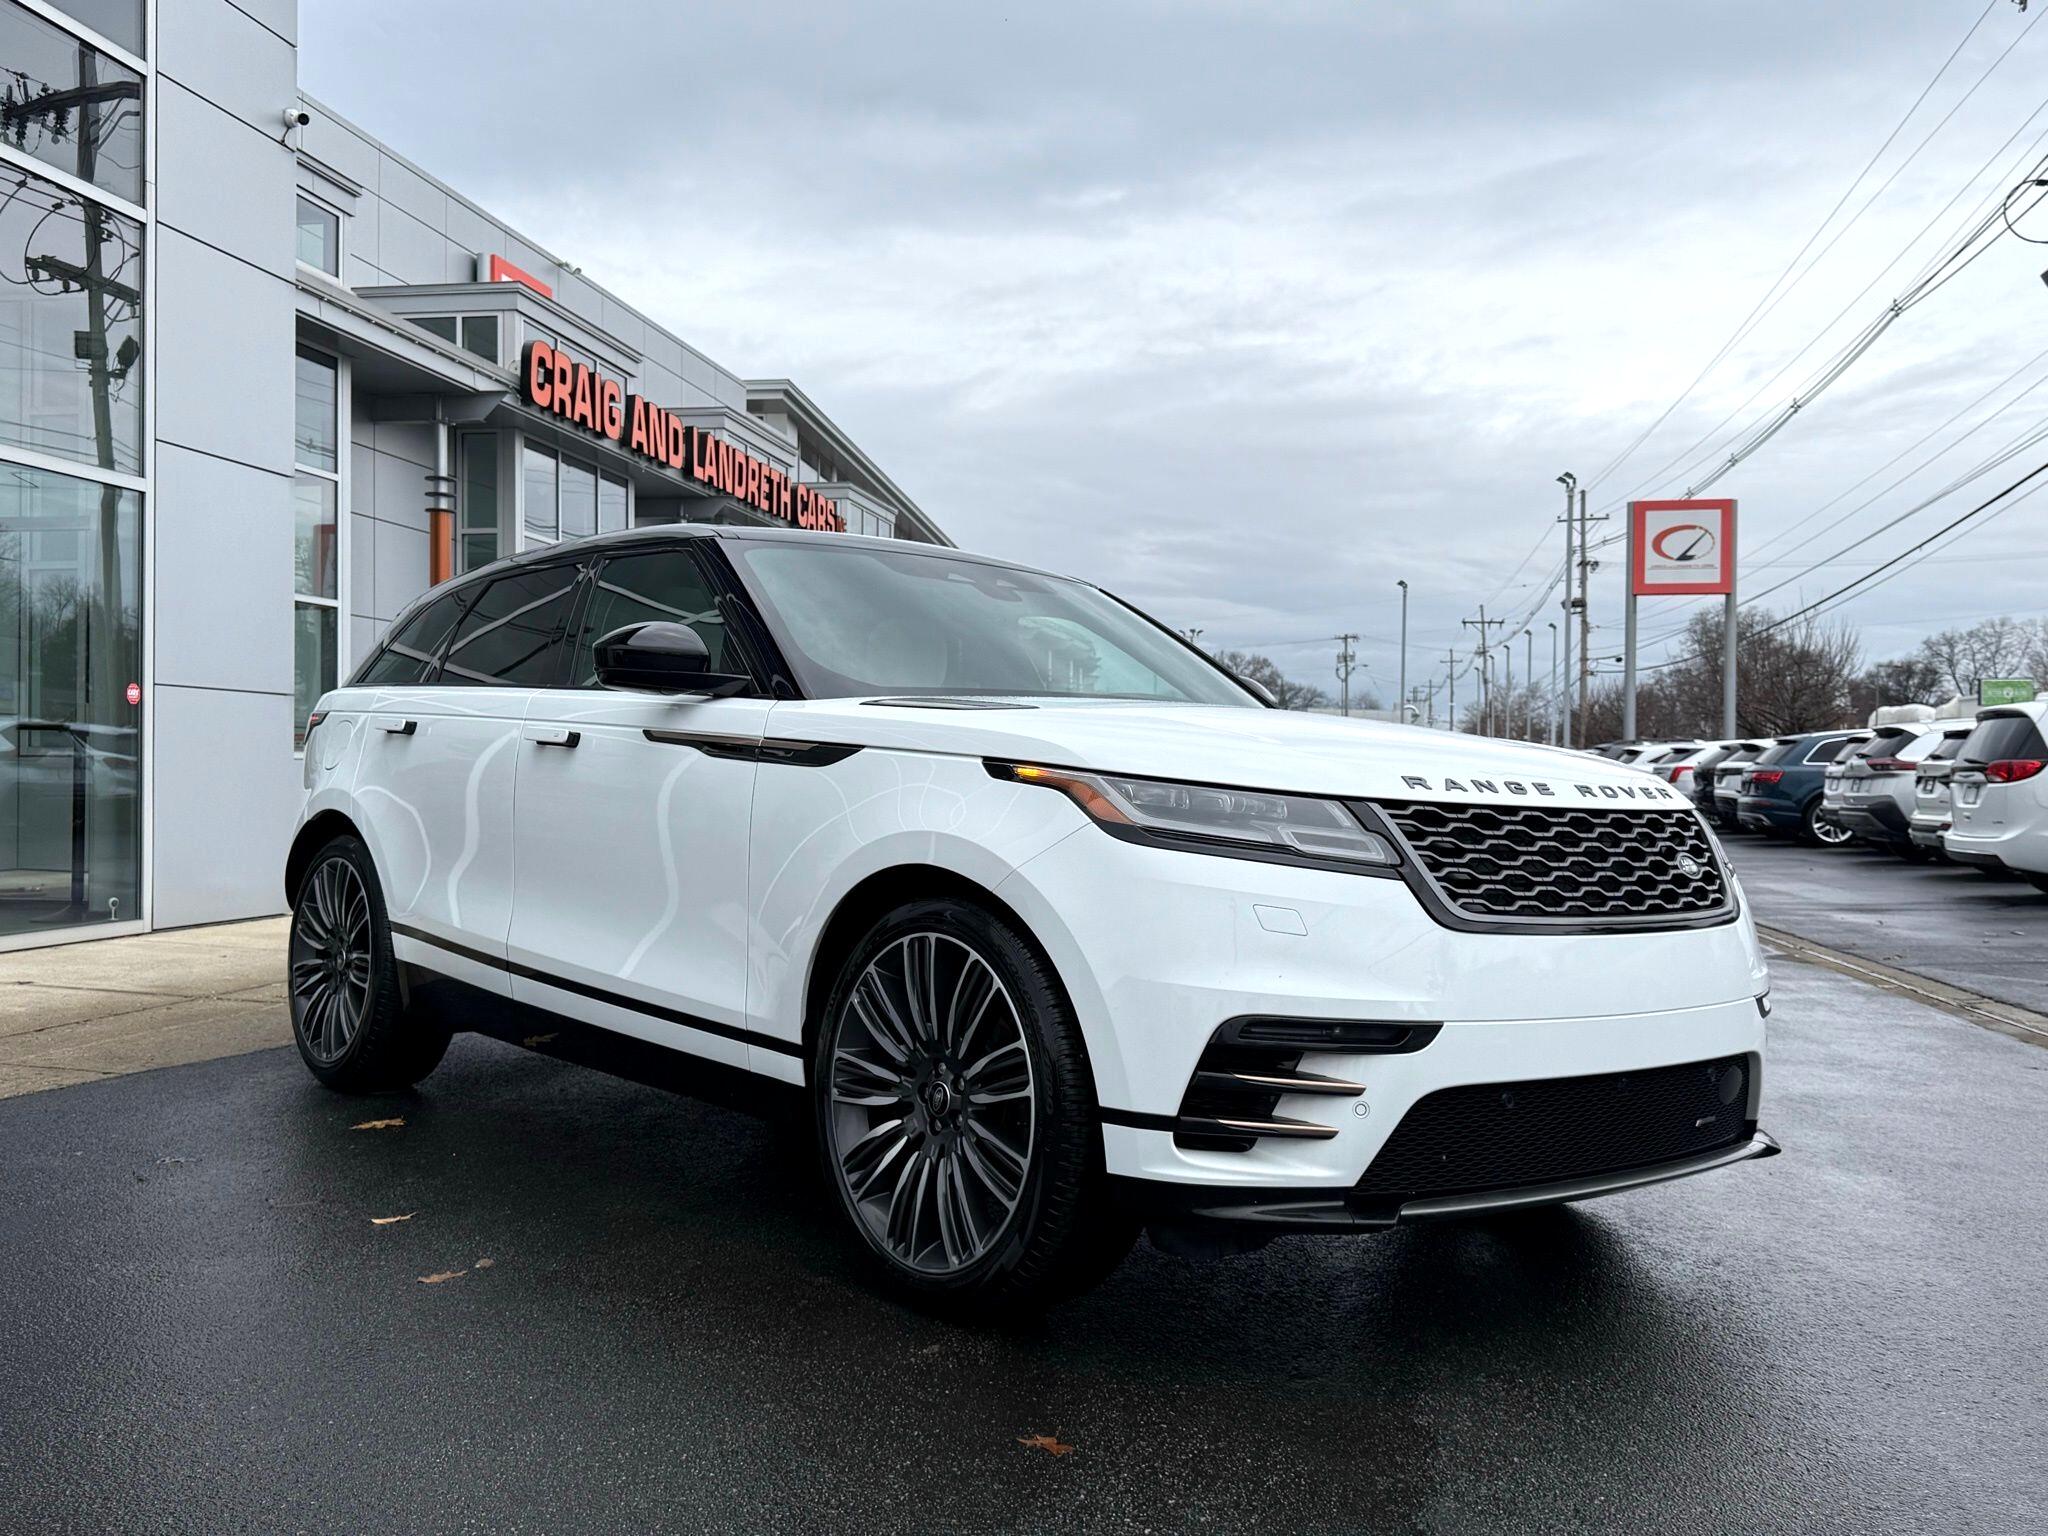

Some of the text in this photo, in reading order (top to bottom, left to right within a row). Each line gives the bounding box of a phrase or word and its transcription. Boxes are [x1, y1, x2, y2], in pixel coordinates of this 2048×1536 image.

[531, 340, 836, 532] CRAIG AND LANDRETH CARS
[1401, 775, 1674, 800] RANGE ROVER
